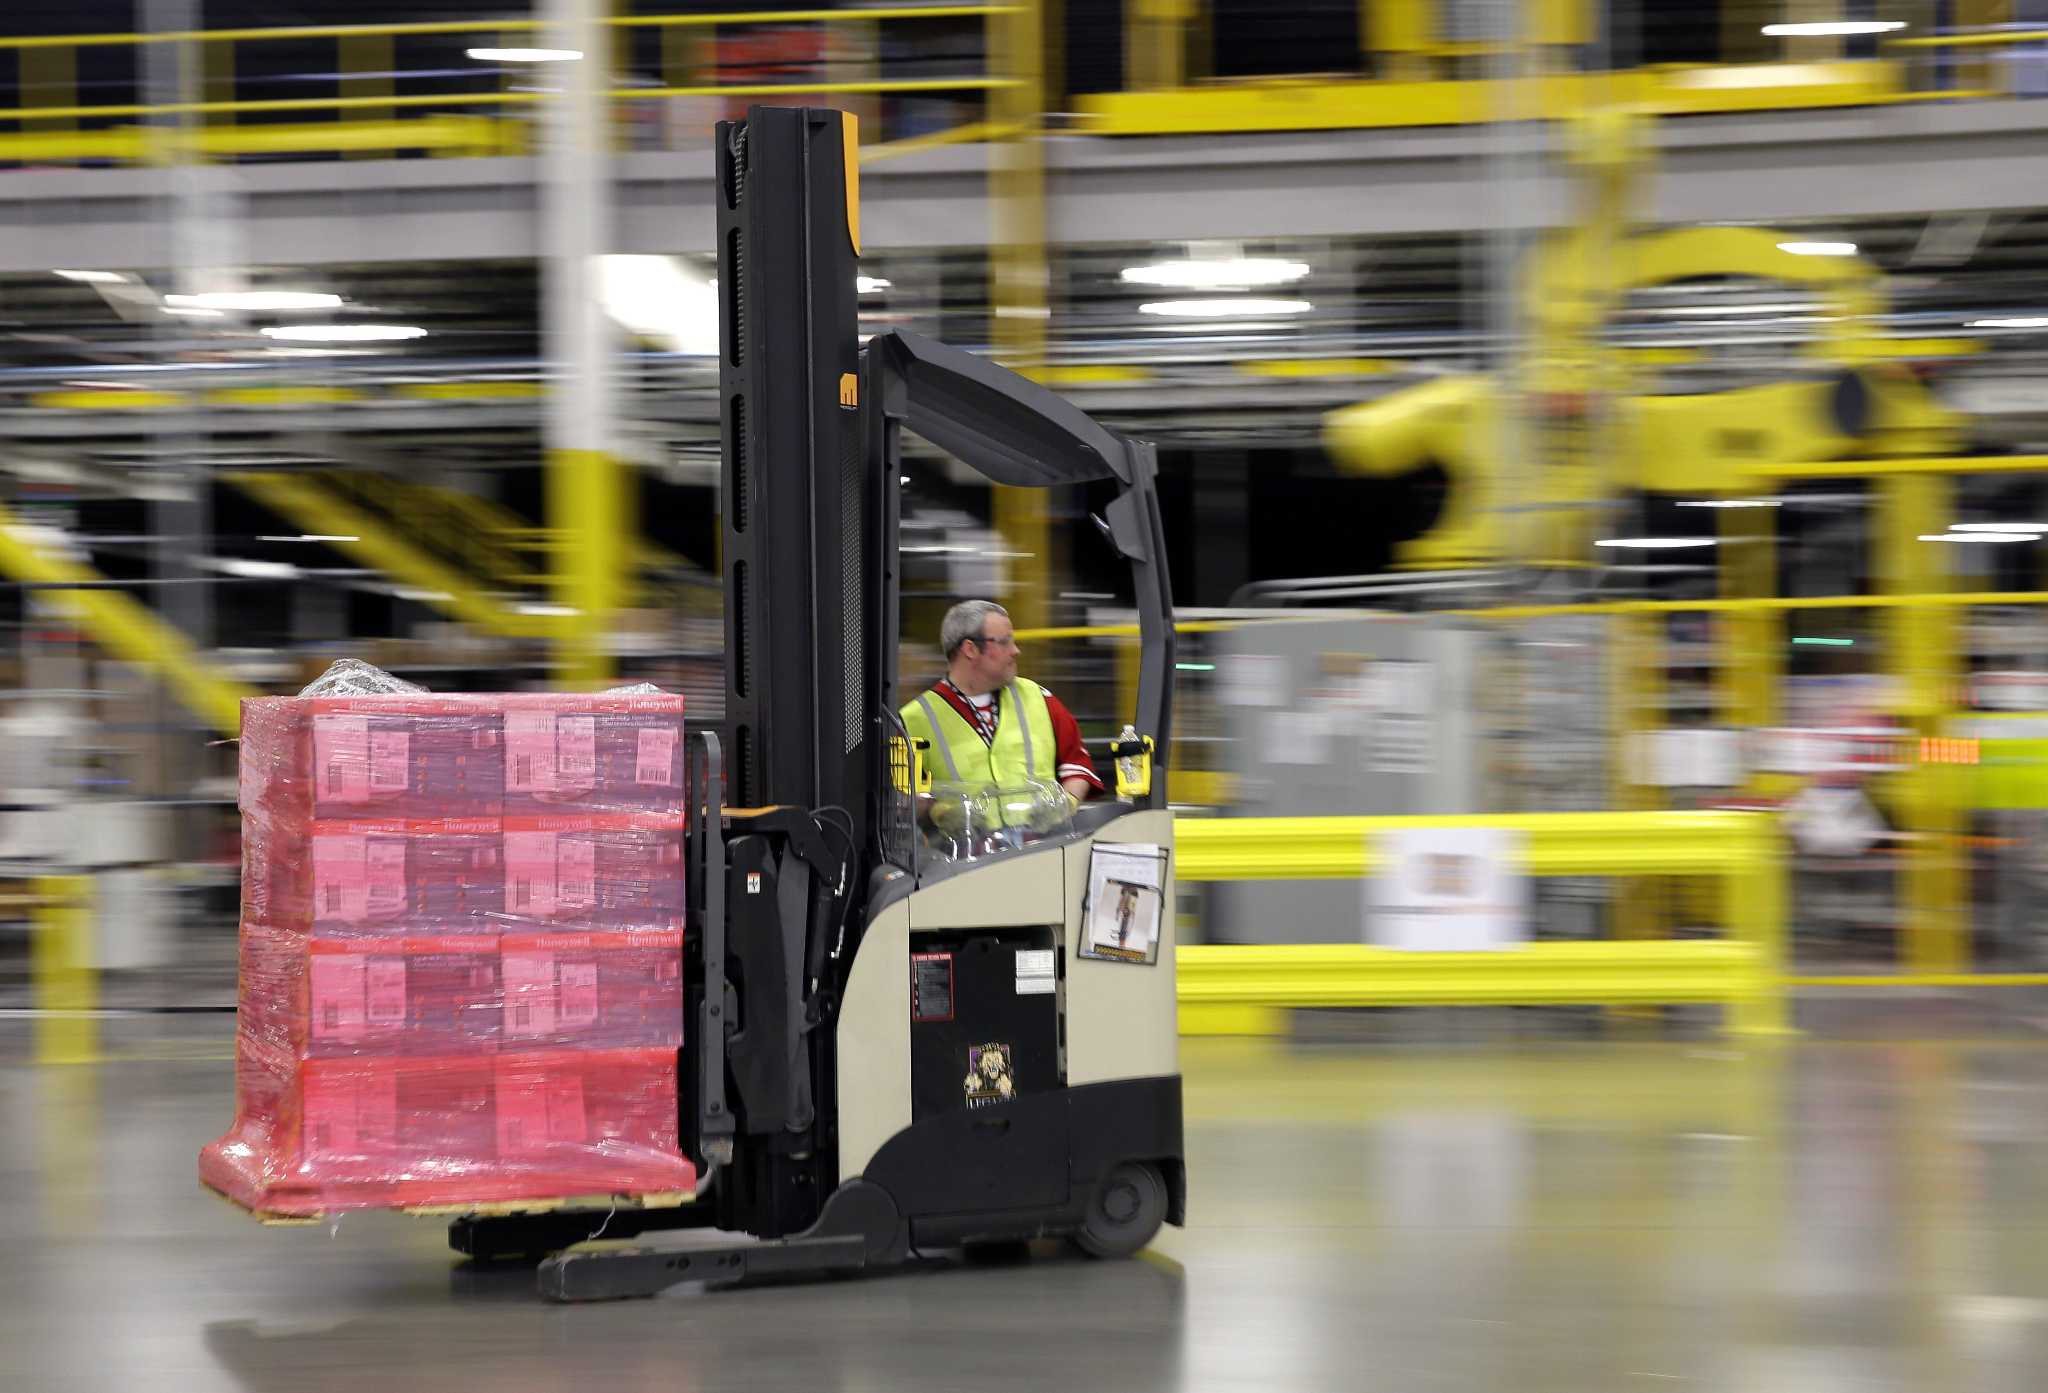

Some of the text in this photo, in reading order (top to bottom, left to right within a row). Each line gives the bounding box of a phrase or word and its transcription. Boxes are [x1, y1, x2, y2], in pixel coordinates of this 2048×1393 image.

[629, 697, 681, 711] Honeywell
[537, 935, 590, 949] Honeywell
[628, 932, 680, 946] Honeywell
